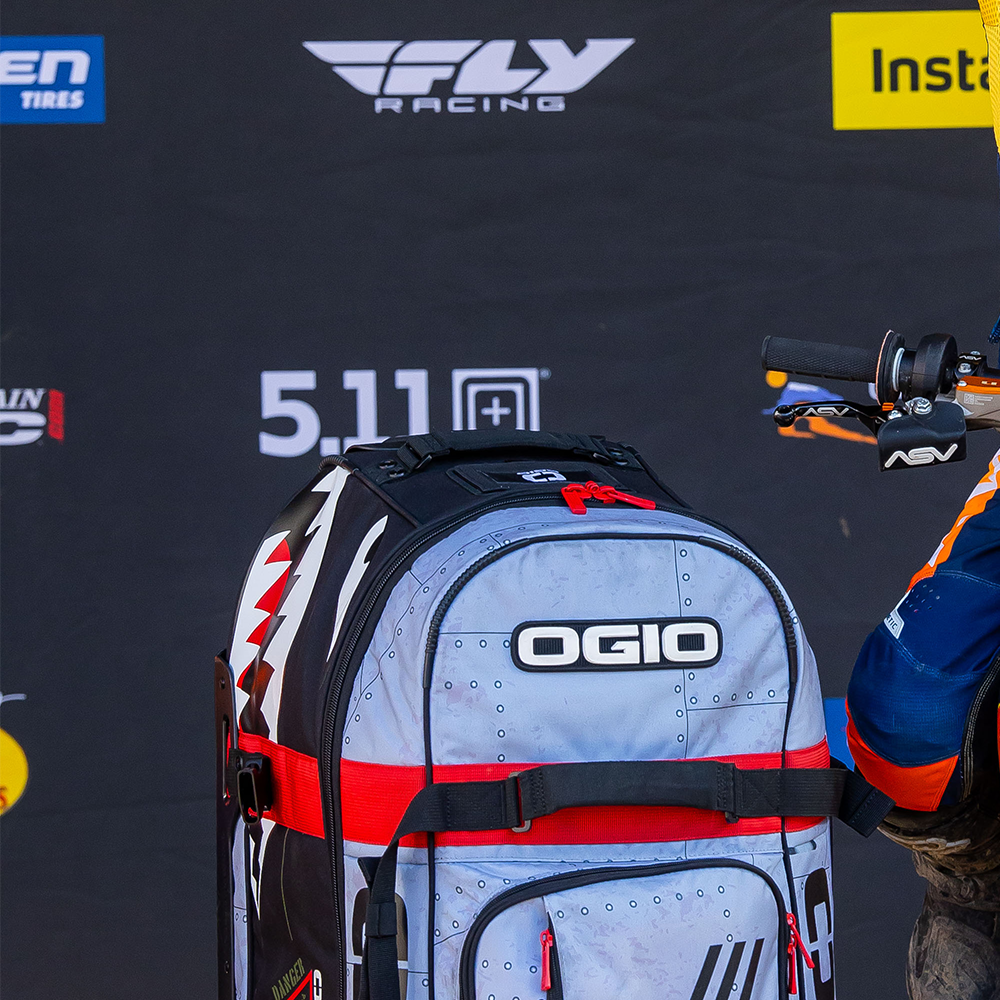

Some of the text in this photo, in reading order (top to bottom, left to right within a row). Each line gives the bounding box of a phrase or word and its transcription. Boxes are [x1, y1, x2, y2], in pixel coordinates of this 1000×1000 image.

[302, 37, 636, 96] FLY
[20, 89, 85, 110] TIRES
[374, 96, 566, 114] RACING
[258, 368, 430, 458] 5.11
[884, 443, 959, 469] ASV
[517, 621, 719, 667] OGIO
[271, 957, 306, 1000] DANGER
